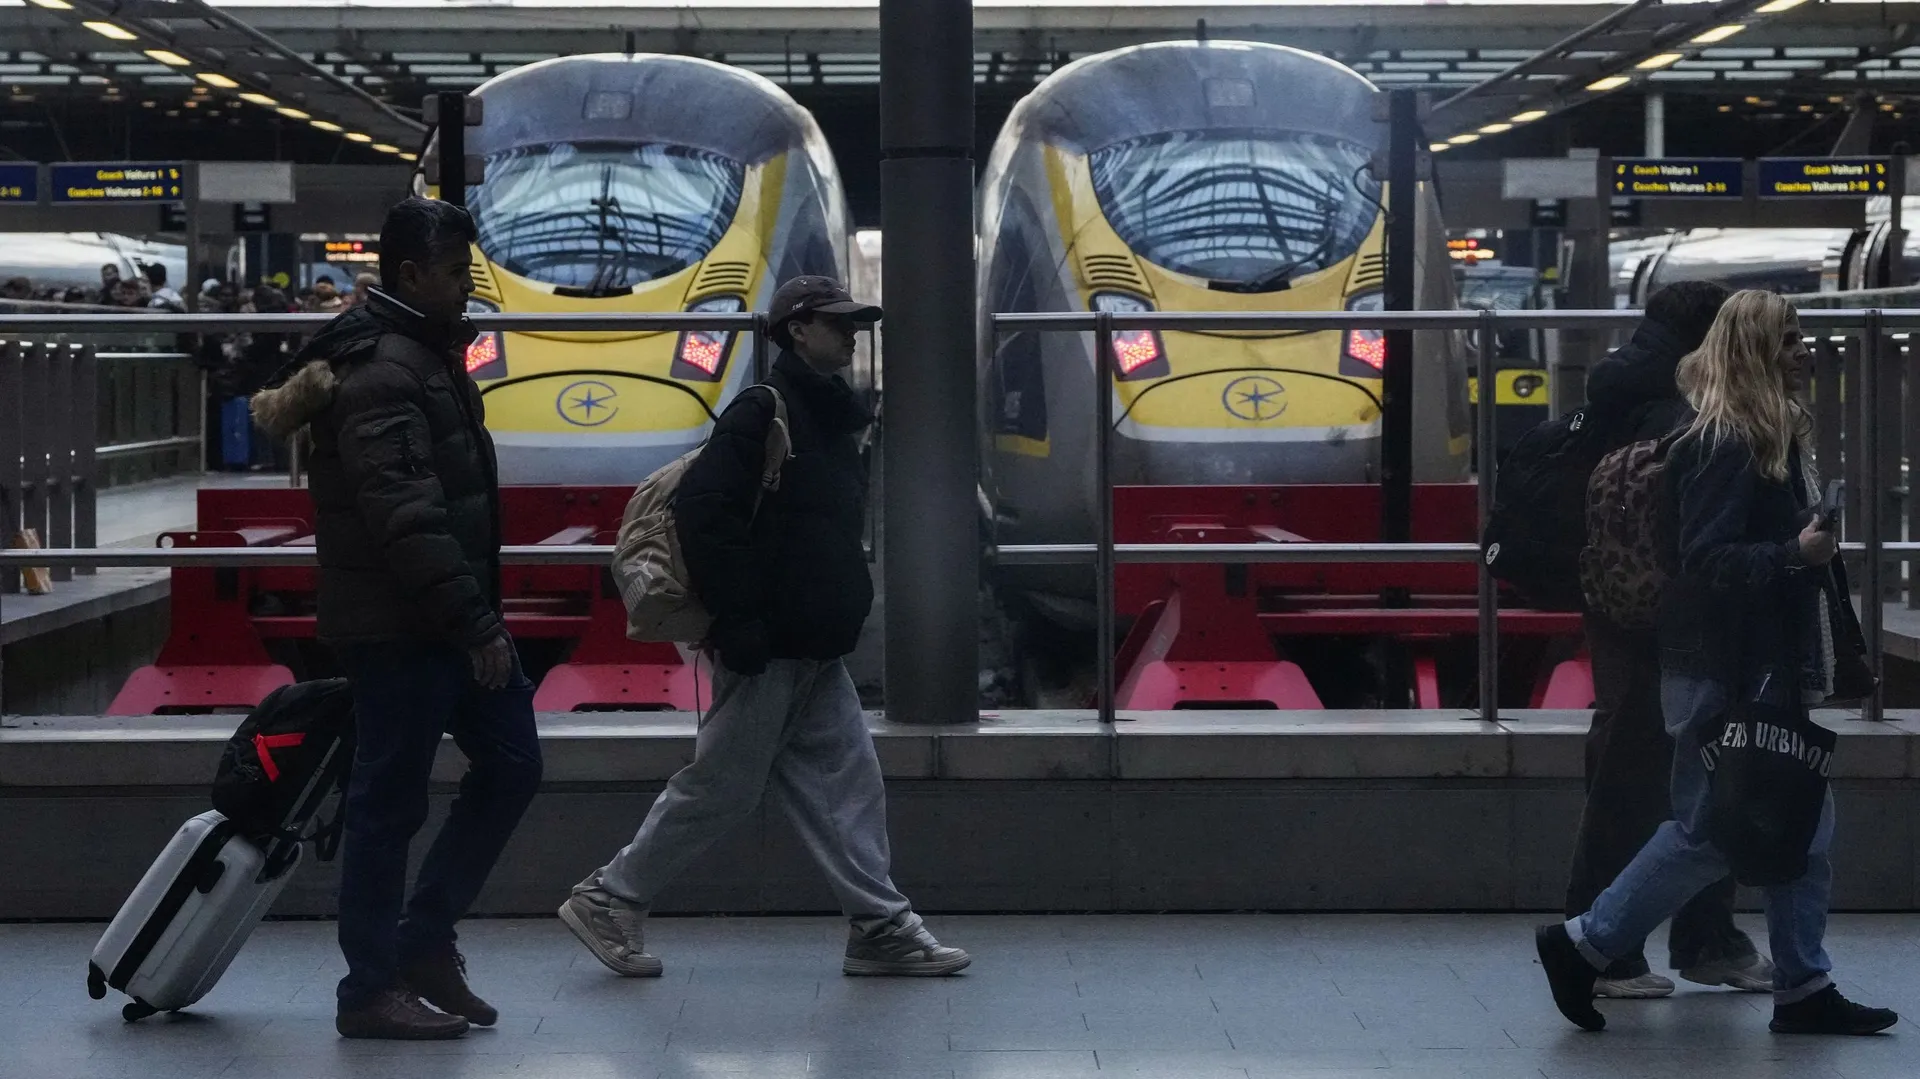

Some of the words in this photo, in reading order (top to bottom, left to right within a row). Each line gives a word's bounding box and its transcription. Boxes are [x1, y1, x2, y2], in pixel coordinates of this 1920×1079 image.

[124, 169, 157, 181] Voiture
[1660, 165, 1692, 175] Voiture
[1831, 165, 1863, 175] Voiture
